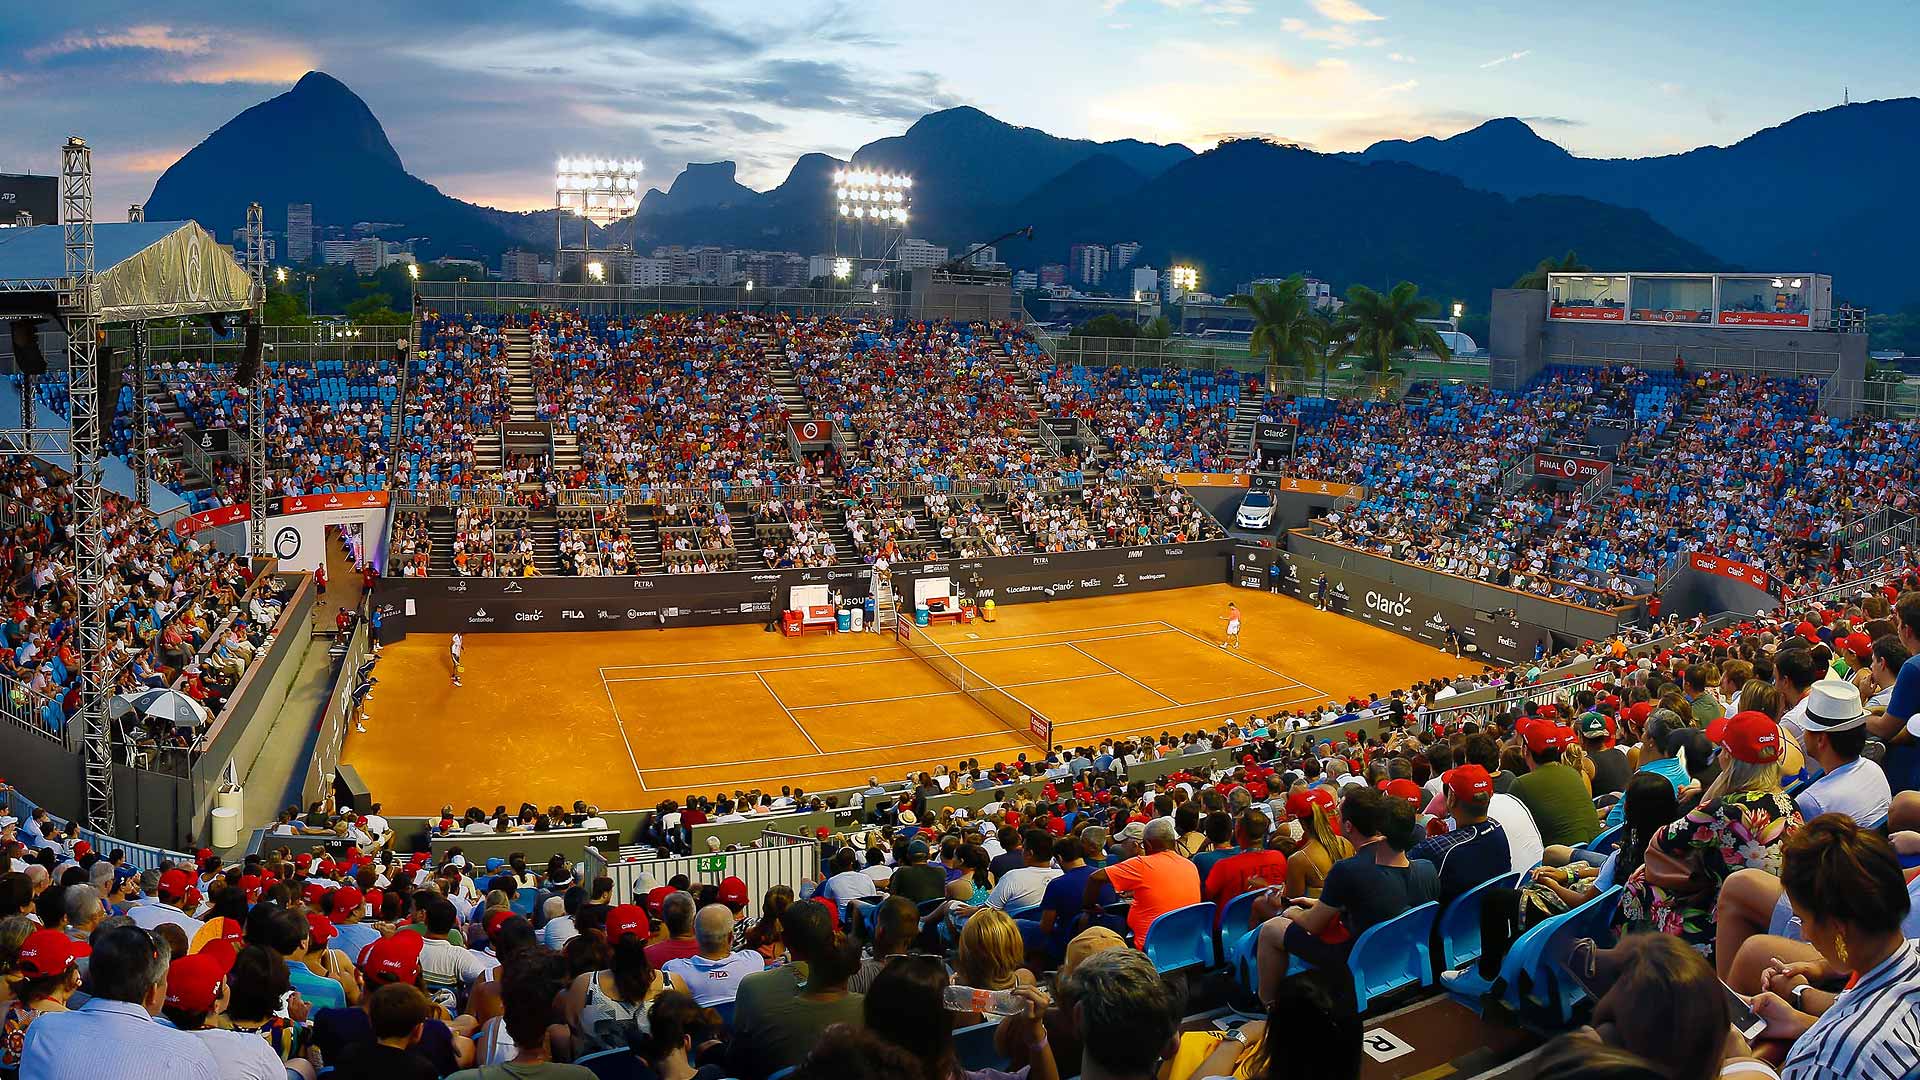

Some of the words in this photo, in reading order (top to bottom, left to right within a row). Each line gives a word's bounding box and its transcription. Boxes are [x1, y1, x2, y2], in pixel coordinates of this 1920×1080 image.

[1724, 315, 1741, 323] Claro
[1264, 428, 1288, 438] Claro
[1539, 460, 1561, 471] FINAL
[1580, 466, 1598, 476] 2019
[1696, 560, 1717, 570] Claro
[1727, 567, 1745, 577] Claro
[1139, 573, 1166, 581] Booking.com
[634, 580, 653, 588] PETRA
[1052, 580, 1074, 591] Claro
[1365, 591, 1412, 617] Claro
[515, 610, 543, 621] Claro
[562, 610, 585, 619] FILA
[1498, 635, 1517, 649] FedEx
[1759, 732, 1775, 743] Claro
[621, 921, 638, 929] Claro
[709, 971, 729, 980] FILA
[1364, 1035, 1398, 1052] R
